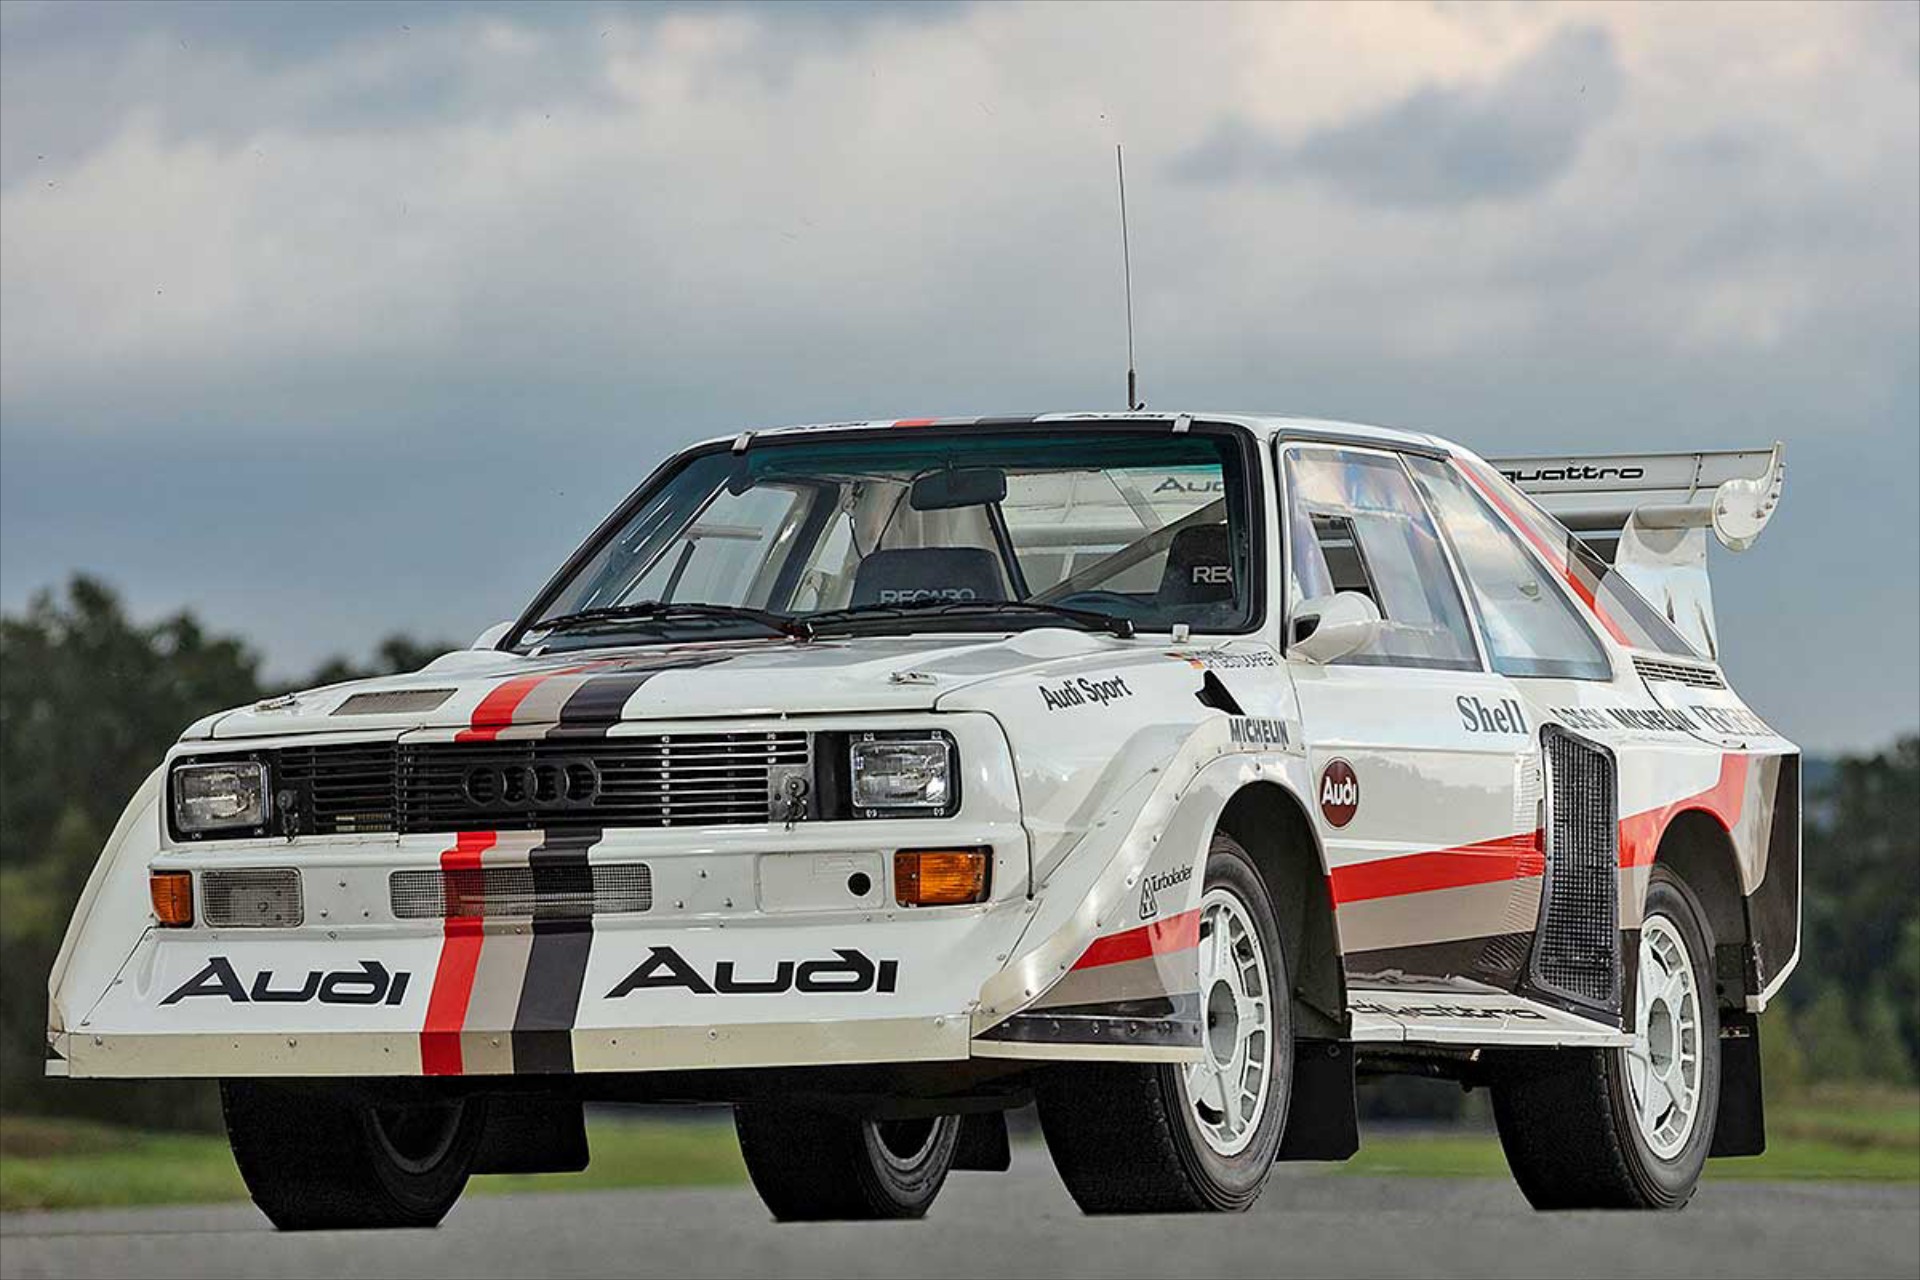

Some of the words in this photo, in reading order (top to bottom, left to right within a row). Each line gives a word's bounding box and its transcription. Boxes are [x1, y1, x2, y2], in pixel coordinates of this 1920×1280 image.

[1499, 466, 1644, 484] quattro
[1038, 679, 1087, 711] Audi
[1076, 675, 1133, 707] Sport
[1228, 718, 1290, 745] MICHELIN
[1456, 695, 1530, 735] Shell
[1605, 708, 1701, 731] MICHELIN
[1321, 776, 1358, 806] Audi
[157, 956, 412, 1007] Audi
[603, 946, 900, 999] Audi
